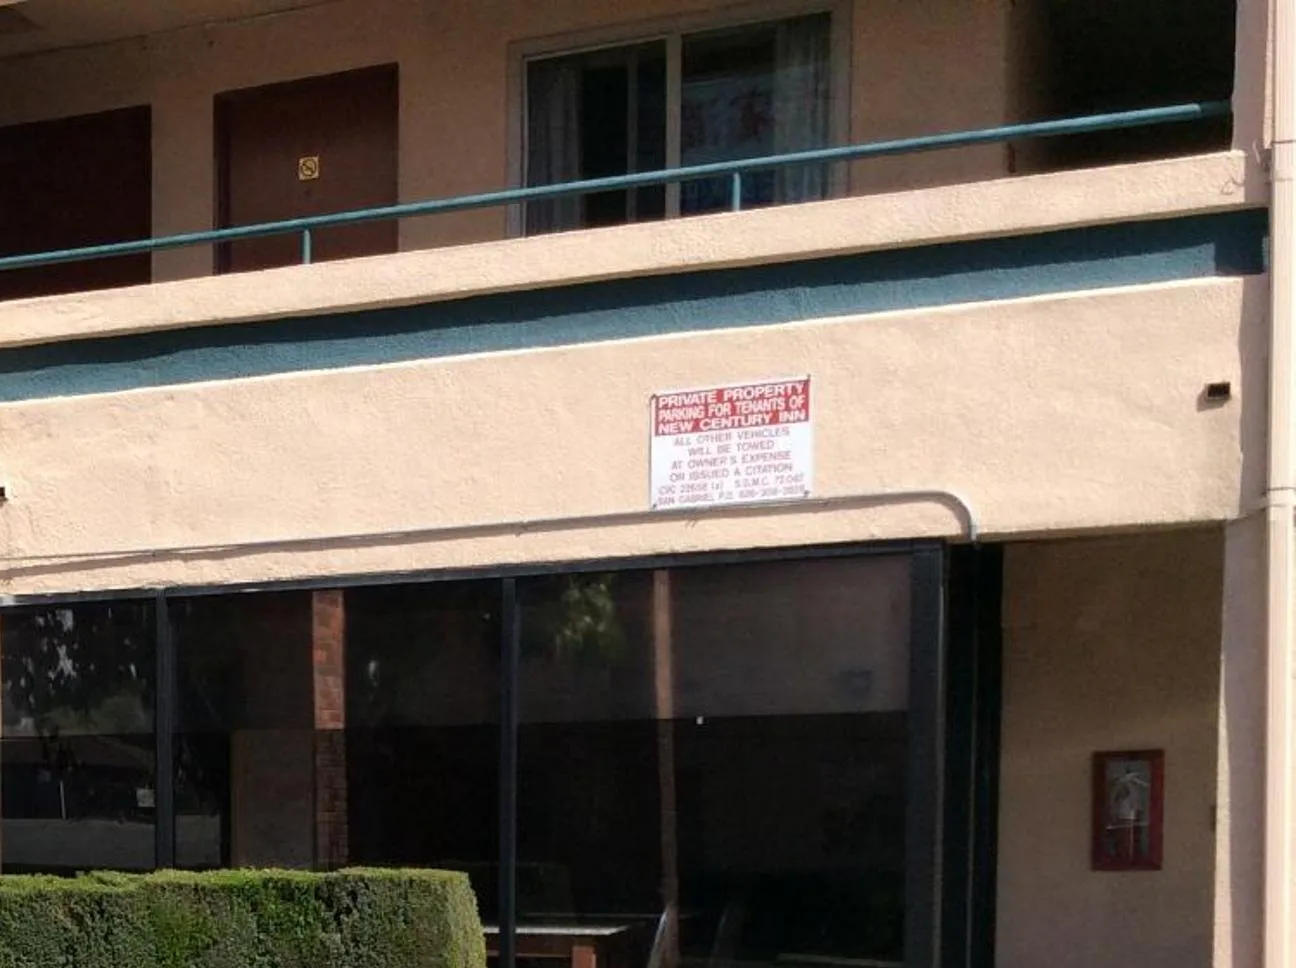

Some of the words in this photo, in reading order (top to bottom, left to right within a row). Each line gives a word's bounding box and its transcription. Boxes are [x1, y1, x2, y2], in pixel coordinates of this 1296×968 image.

[659, 390, 718, 409] PRIVATE
[723, 382, 805, 401] PROPERTY
[658, 406, 705, 423] PARKING
[708, 402, 732, 418] FOR
[736, 397, 786, 415] TENANTS
[789, 394, 806, 409] OF
[658, 420, 693, 434] NEW
[699, 413, 773, 431] CENTURY
[779, 409, 805, 424] INN
[674, 436, 691, 447] ALL
[696, 431, 732, 444] OTHER
[737, 426, 790, 440] VEHICLES
[737, 440, 775, 452] TOWED
[671, 460, 683, 470] AT
[741, 450, 792, 463] EXPENSE
[745, 462, 793, 476] CITATION
